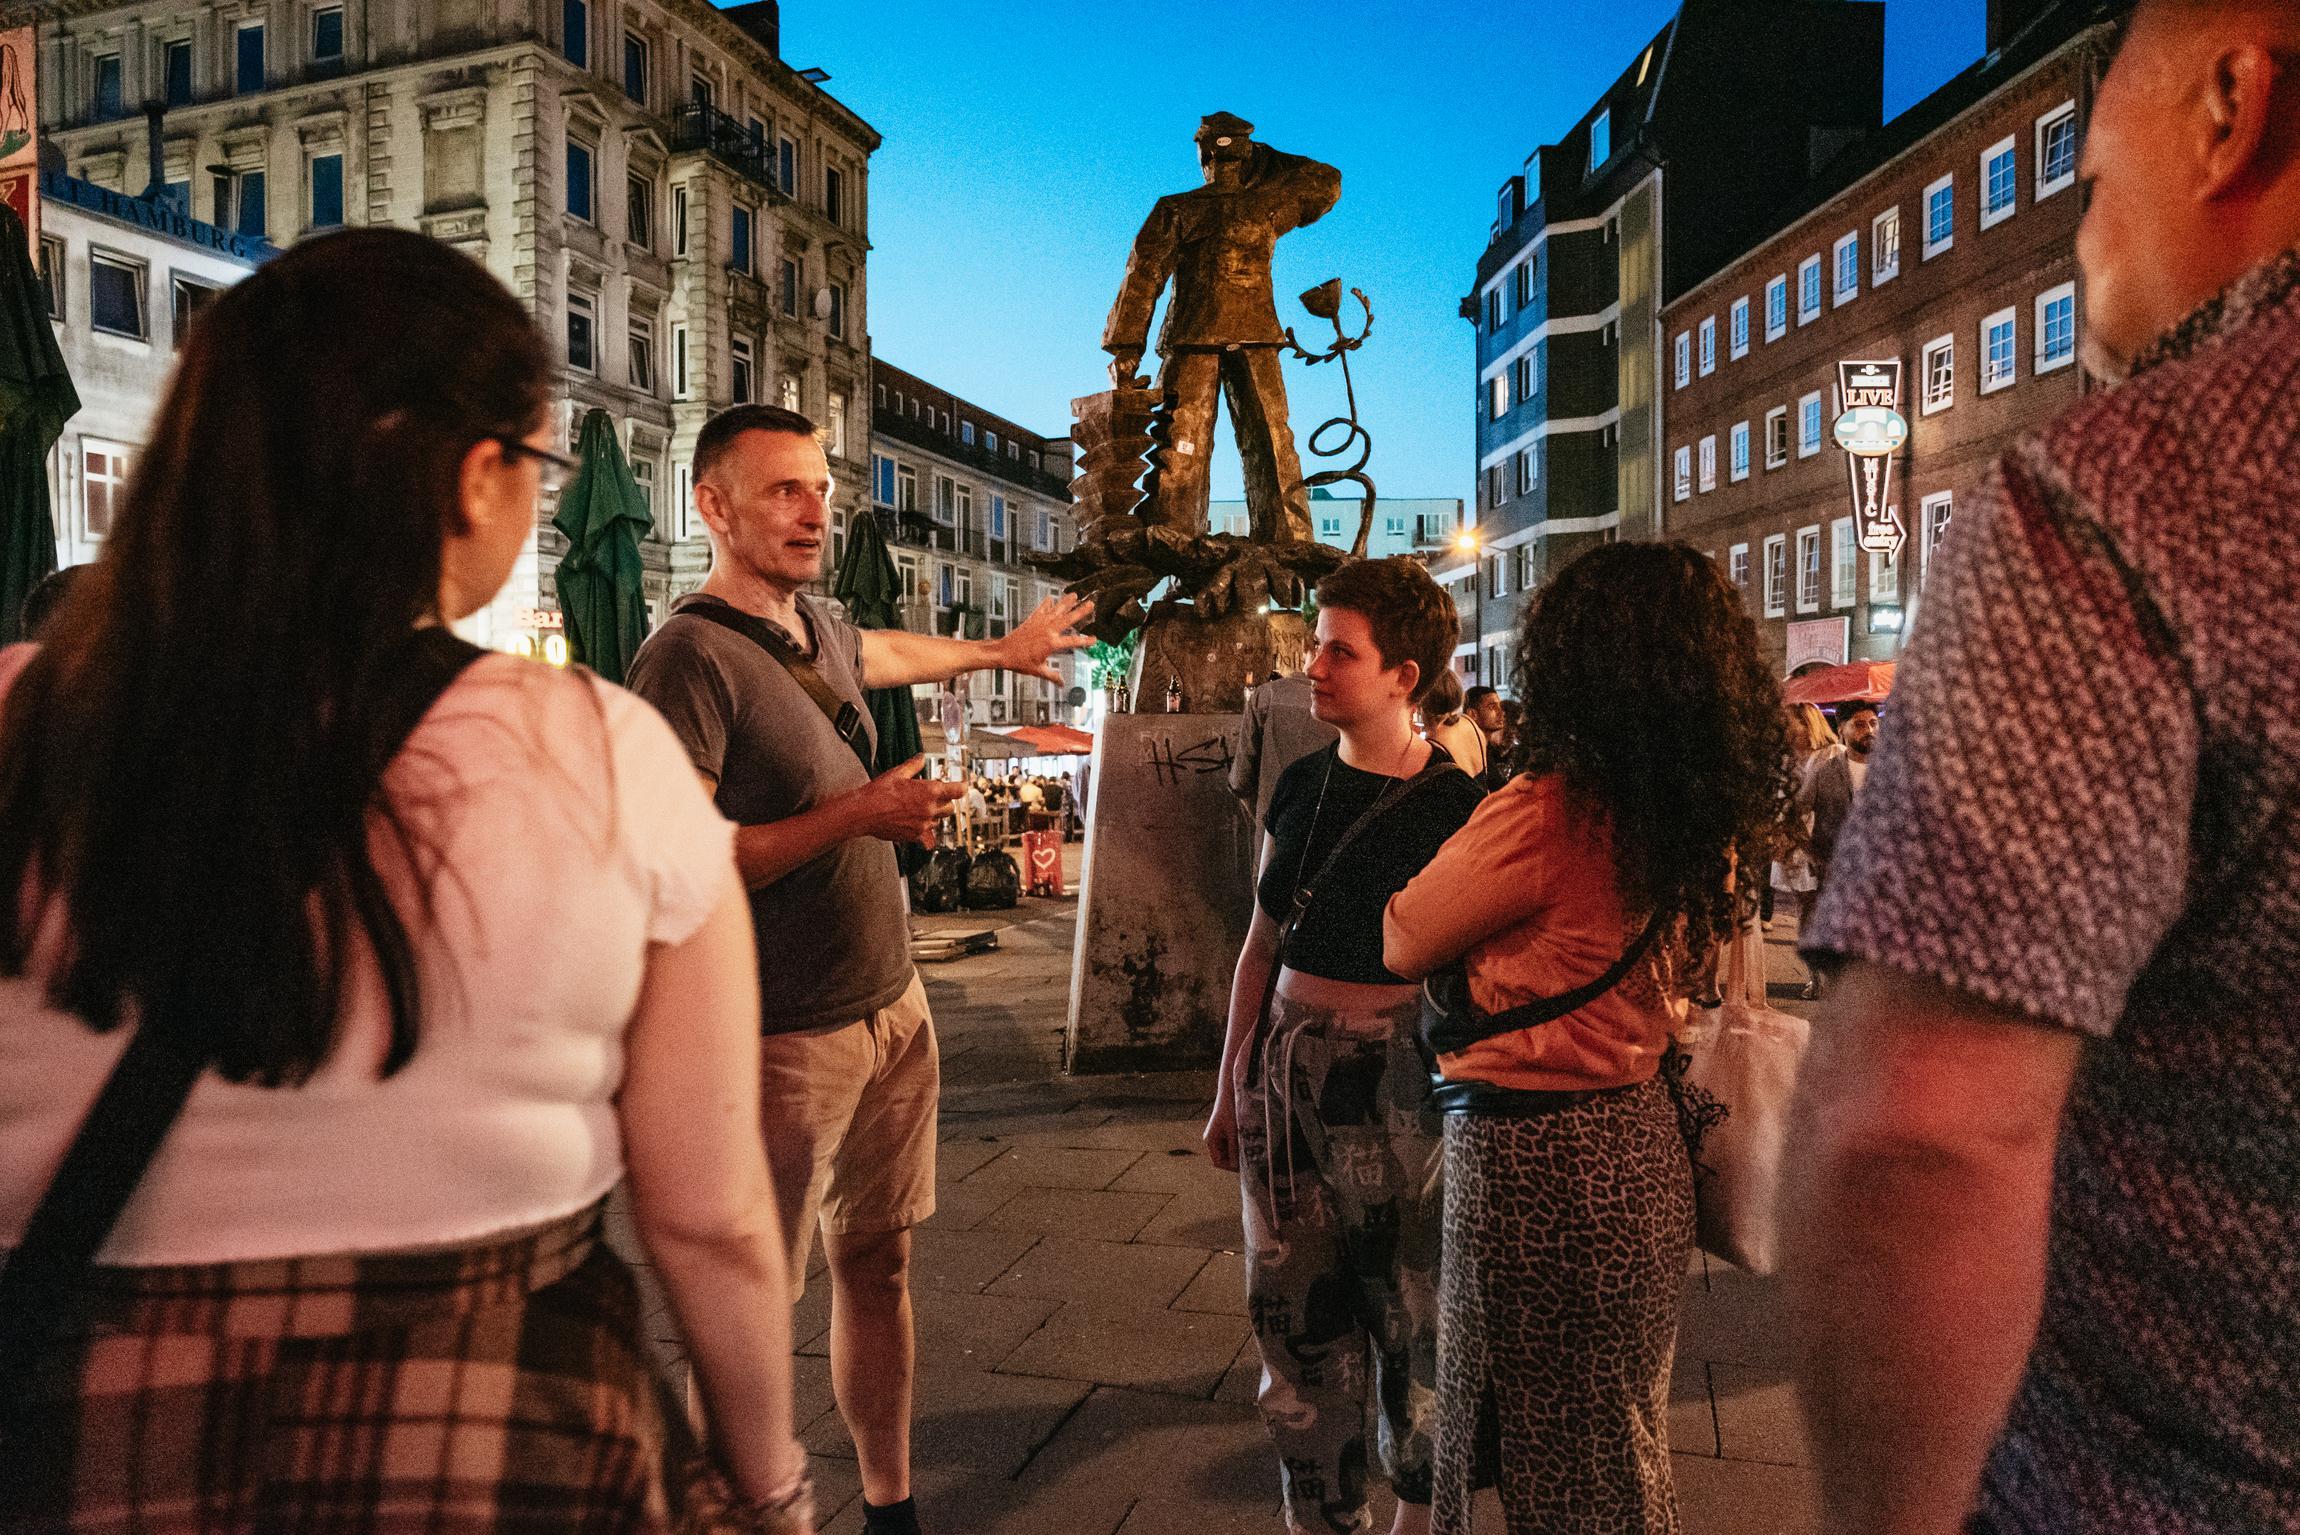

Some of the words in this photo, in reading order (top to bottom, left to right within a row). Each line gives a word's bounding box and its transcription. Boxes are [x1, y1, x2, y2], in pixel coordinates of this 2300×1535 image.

[101, 189, 245, 257] HAMBURG
[1846, 389, 1894, 406] LIVE
[1863, 458, 1879, 517] MUSIC
[1868, 521, 1895, 536] free
[1863, 535, 1899, 550] entry
[515, 608, 563, 628] Bar
[1333, 1142, 1384, 1187] 猫
